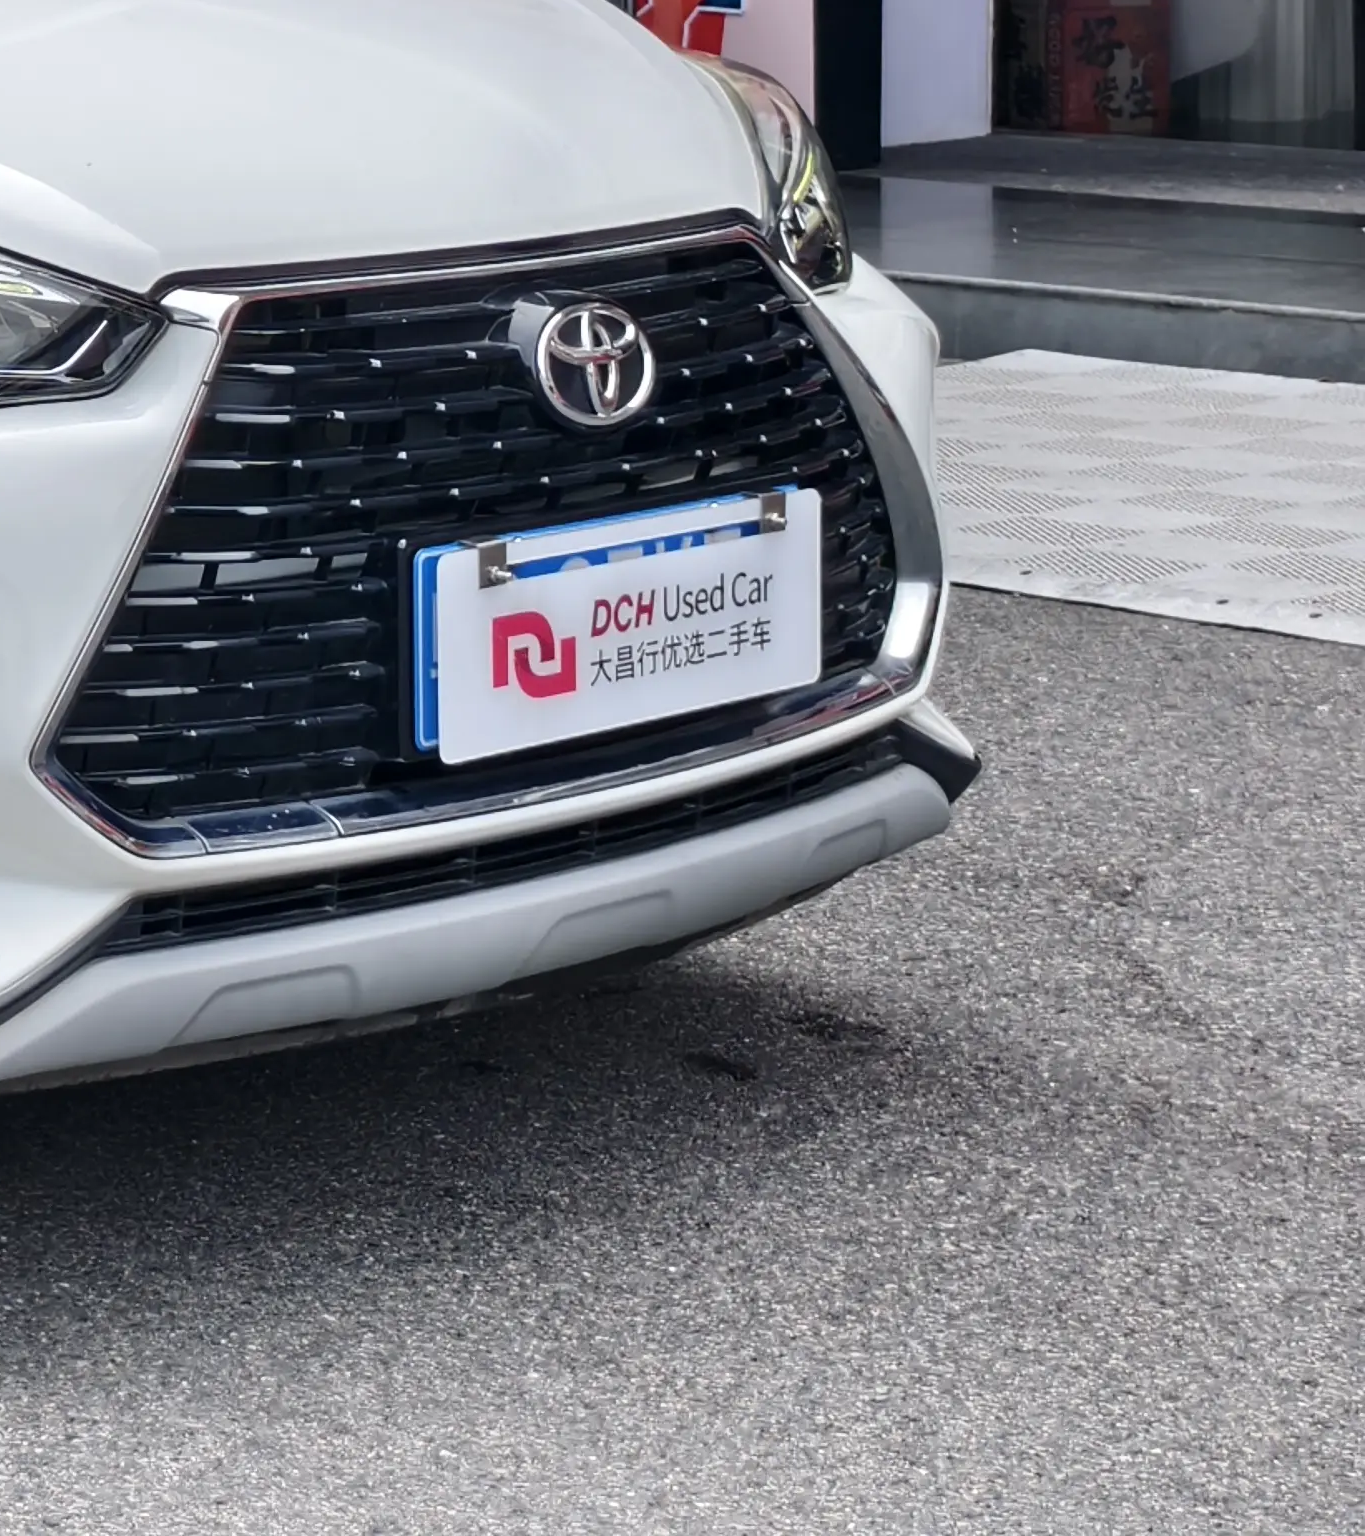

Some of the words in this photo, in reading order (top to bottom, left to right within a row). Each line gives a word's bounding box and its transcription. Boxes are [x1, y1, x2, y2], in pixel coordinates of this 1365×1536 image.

[590, 588, 656, 638] DCH
[663, 572, 725, 622] Used
[731, 571, 774, 608] Car
[590, 616, 772, 687] 大昌行优选二手车
